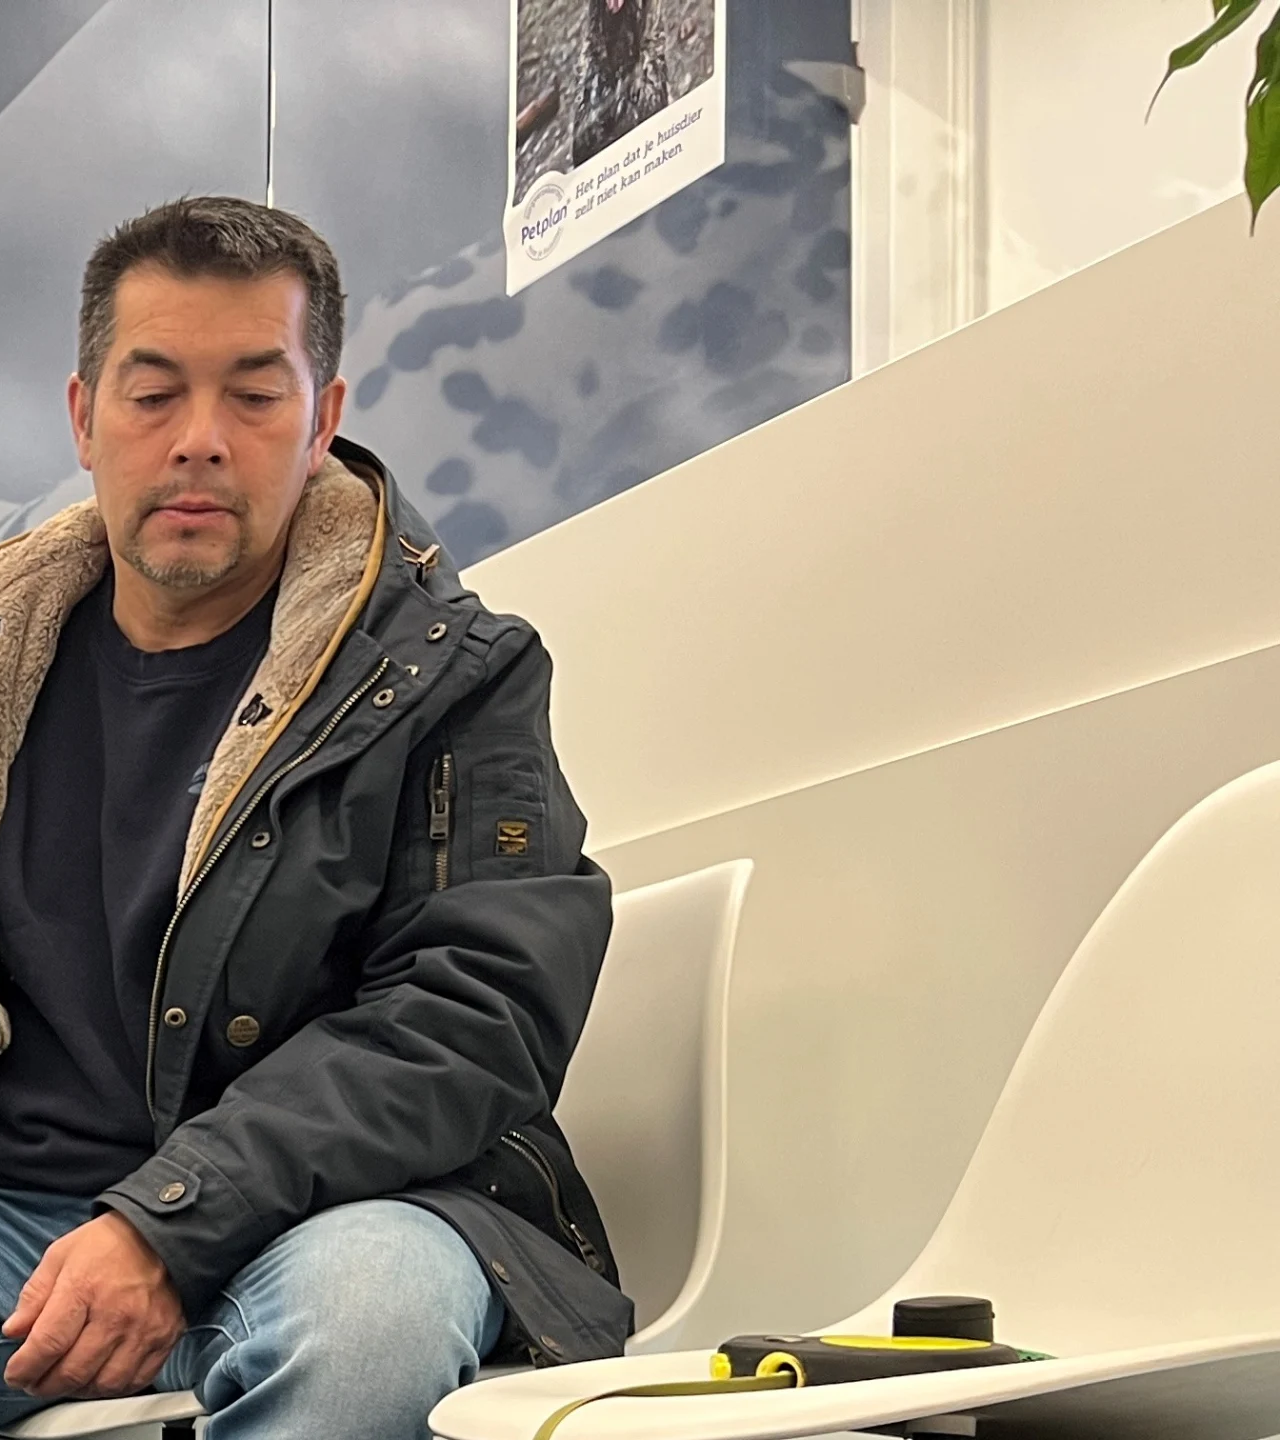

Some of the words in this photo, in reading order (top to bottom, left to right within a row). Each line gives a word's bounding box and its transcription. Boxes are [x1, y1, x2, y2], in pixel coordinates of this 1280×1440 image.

[575, 179, 594, 199] Het
[597, 163, 620, 190] plan
[623, 147, 641, 168] dat
[643, 140, 654, 159] je
[657, 107, 703, 146] huisdier
[575, 195, 595, 220] zelf
[597, 183, 617, 206] niet
[620, 169, 641, 191] kan
[644, 143, 683, 175] maken
[521, 205, 568, 246] Petplan
